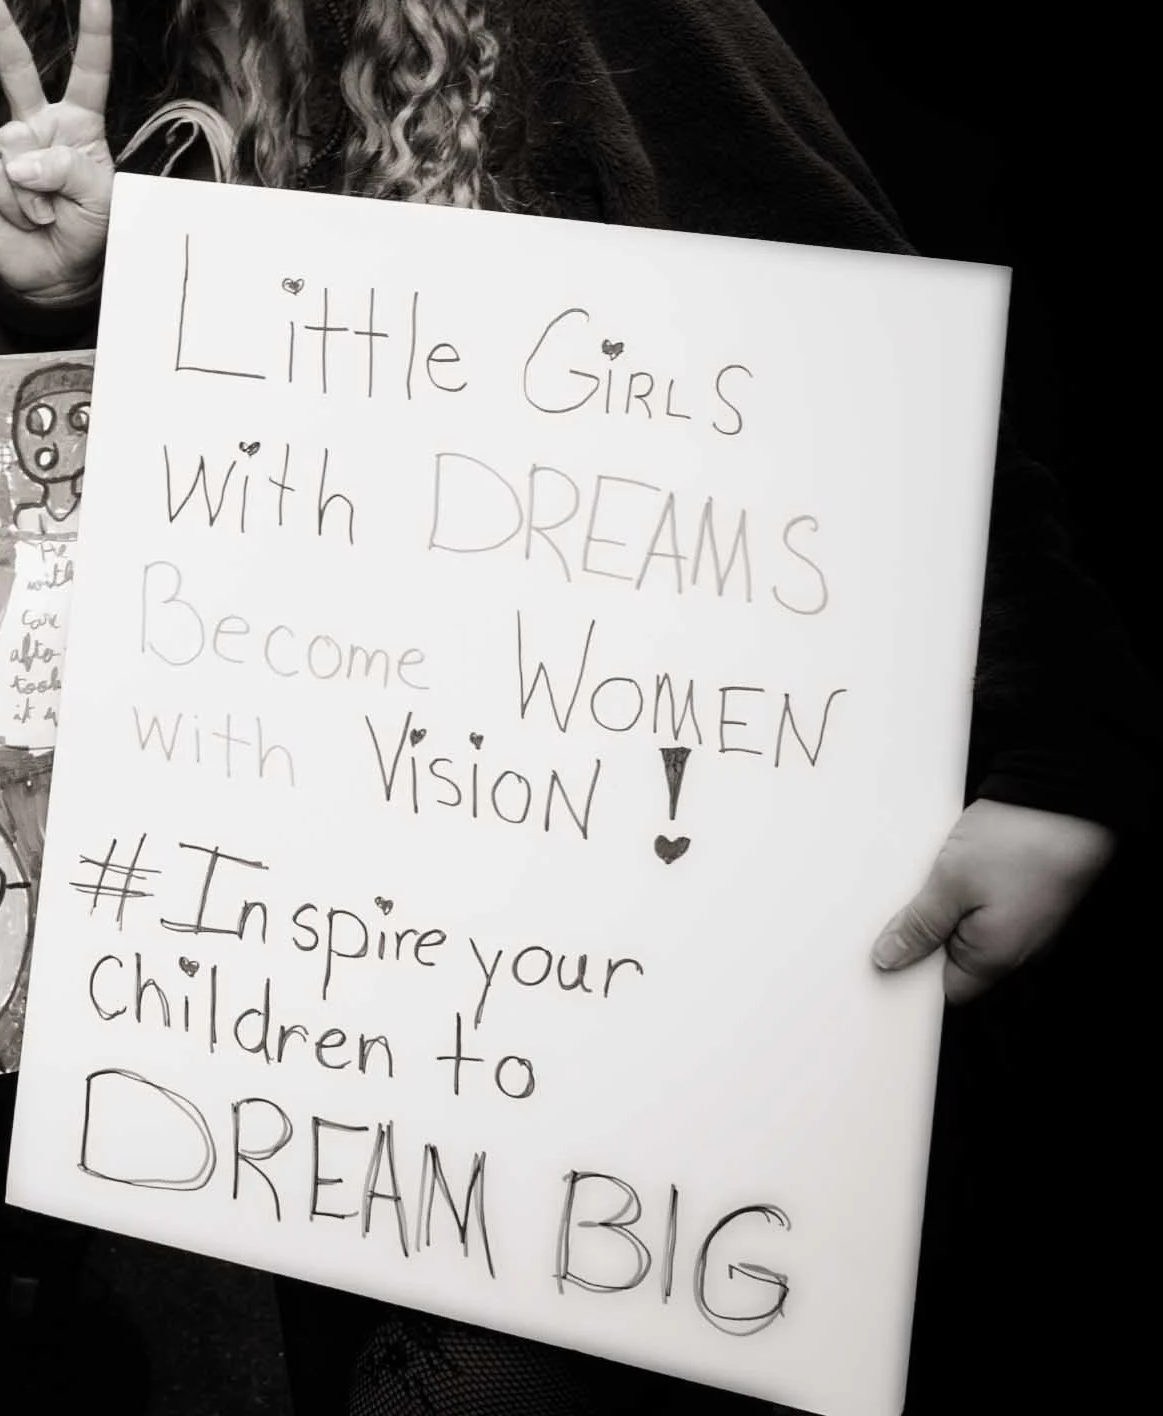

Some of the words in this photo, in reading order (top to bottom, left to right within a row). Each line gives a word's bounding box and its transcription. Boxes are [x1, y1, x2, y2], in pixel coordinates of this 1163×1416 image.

[175, 234, 468, 400] Little
[428, 451, 829, 616] DREAMS
[140, 560, 431, 691] Become
[69, 833, 448, 1001] #Inspire
[469, 937, 644, 1031] your
[437, 1012, 536, 1100] to
[77, 1068, 497, 1280] DREAM
[553, 1169, 793, 1337] BIG
